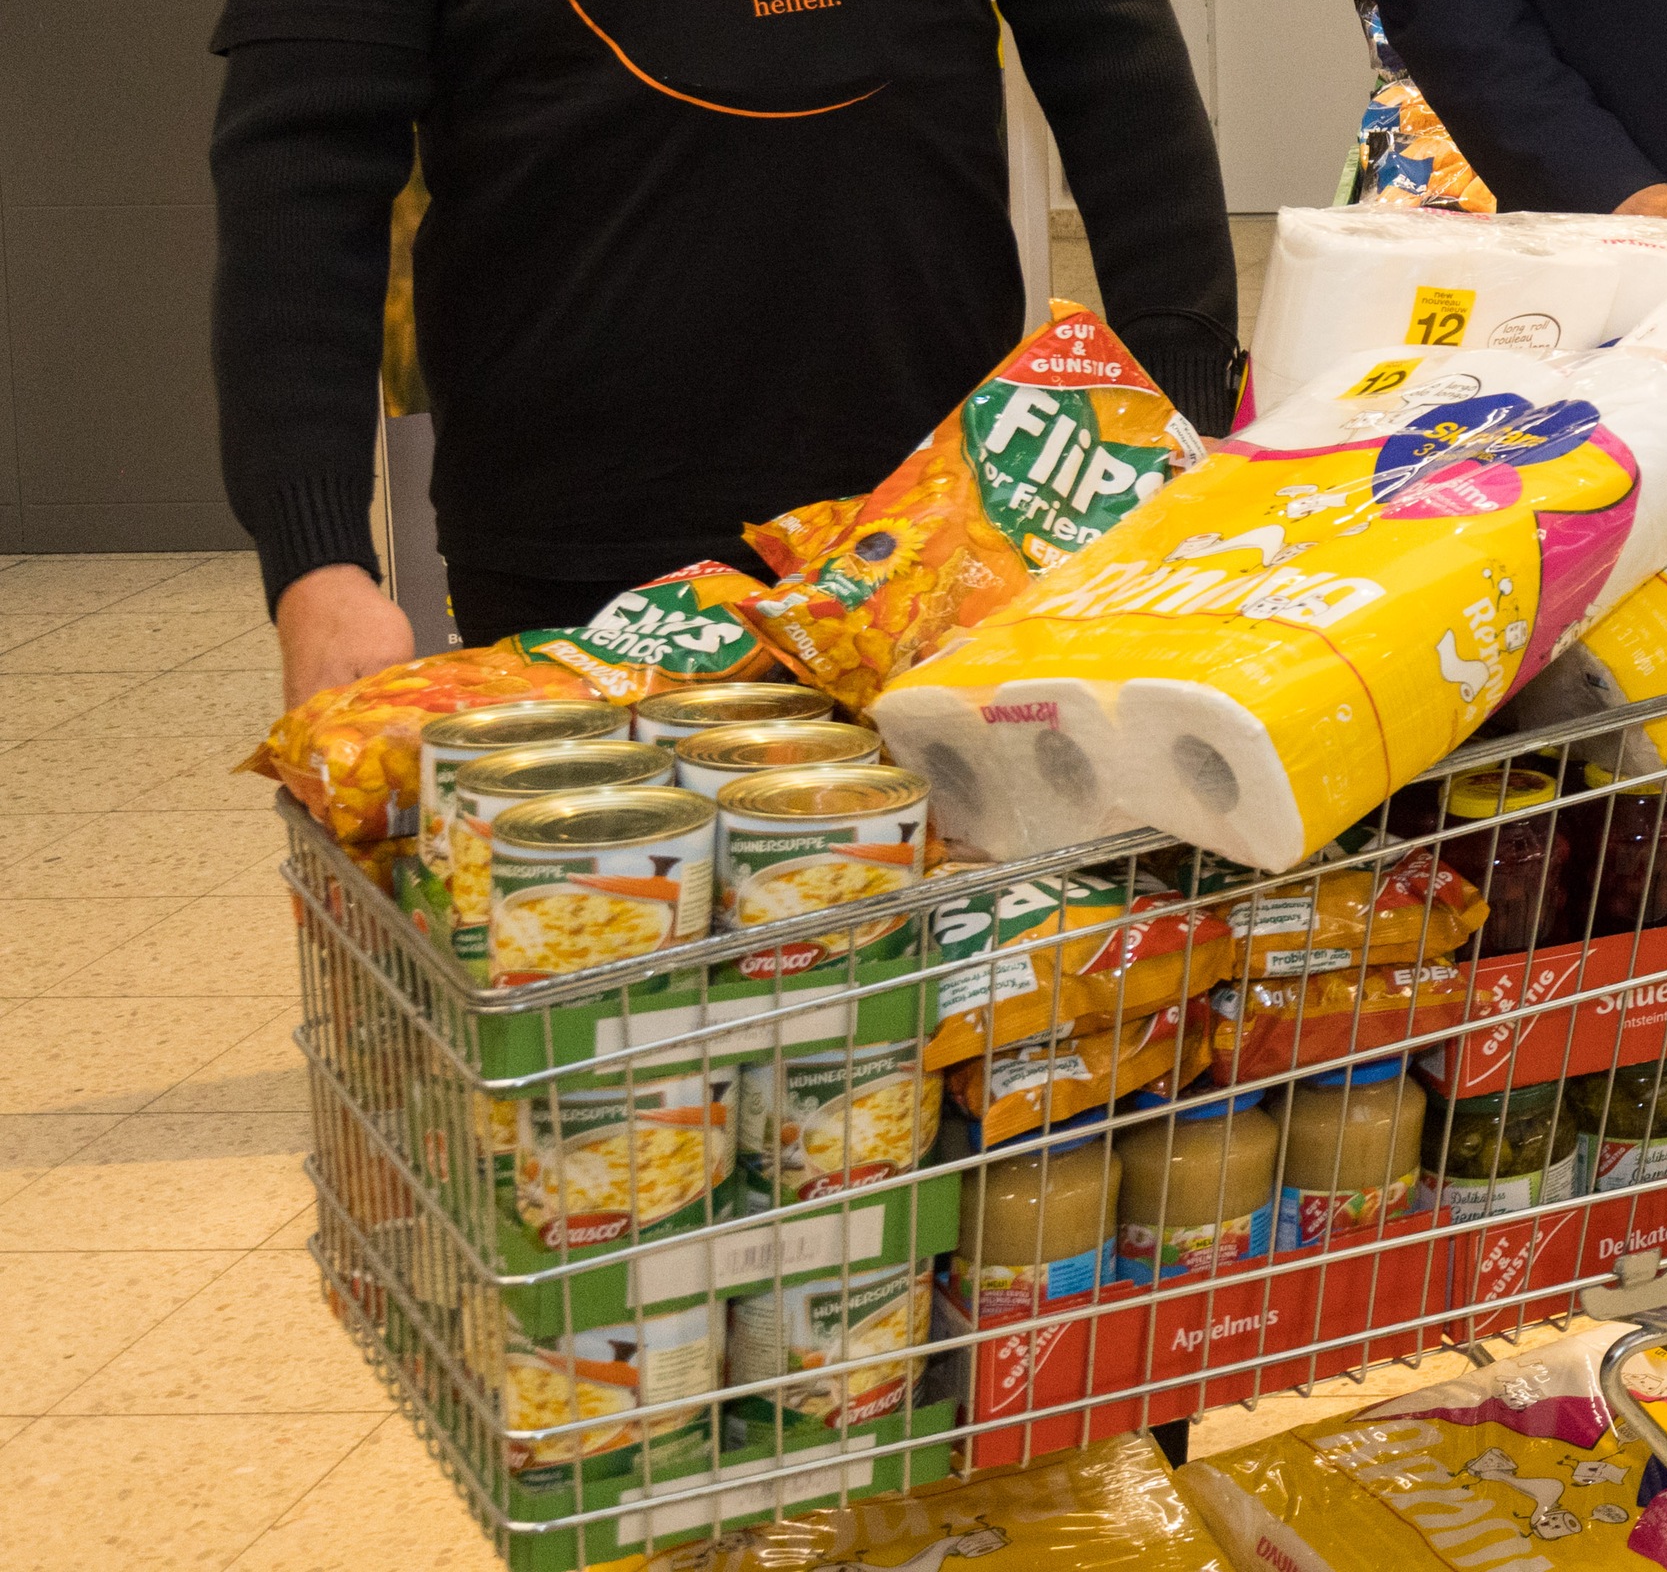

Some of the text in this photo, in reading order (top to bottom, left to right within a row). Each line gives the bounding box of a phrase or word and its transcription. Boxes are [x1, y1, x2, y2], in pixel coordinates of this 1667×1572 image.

[1055, 324, 1096, 340] GUT
[1417, 314, 1465, 346] 12
[1072, 340, 1086, 356] &
[1031, 354, 1122, 378] GÜNSTIG
[1357, 370, 1406, 396] 12
